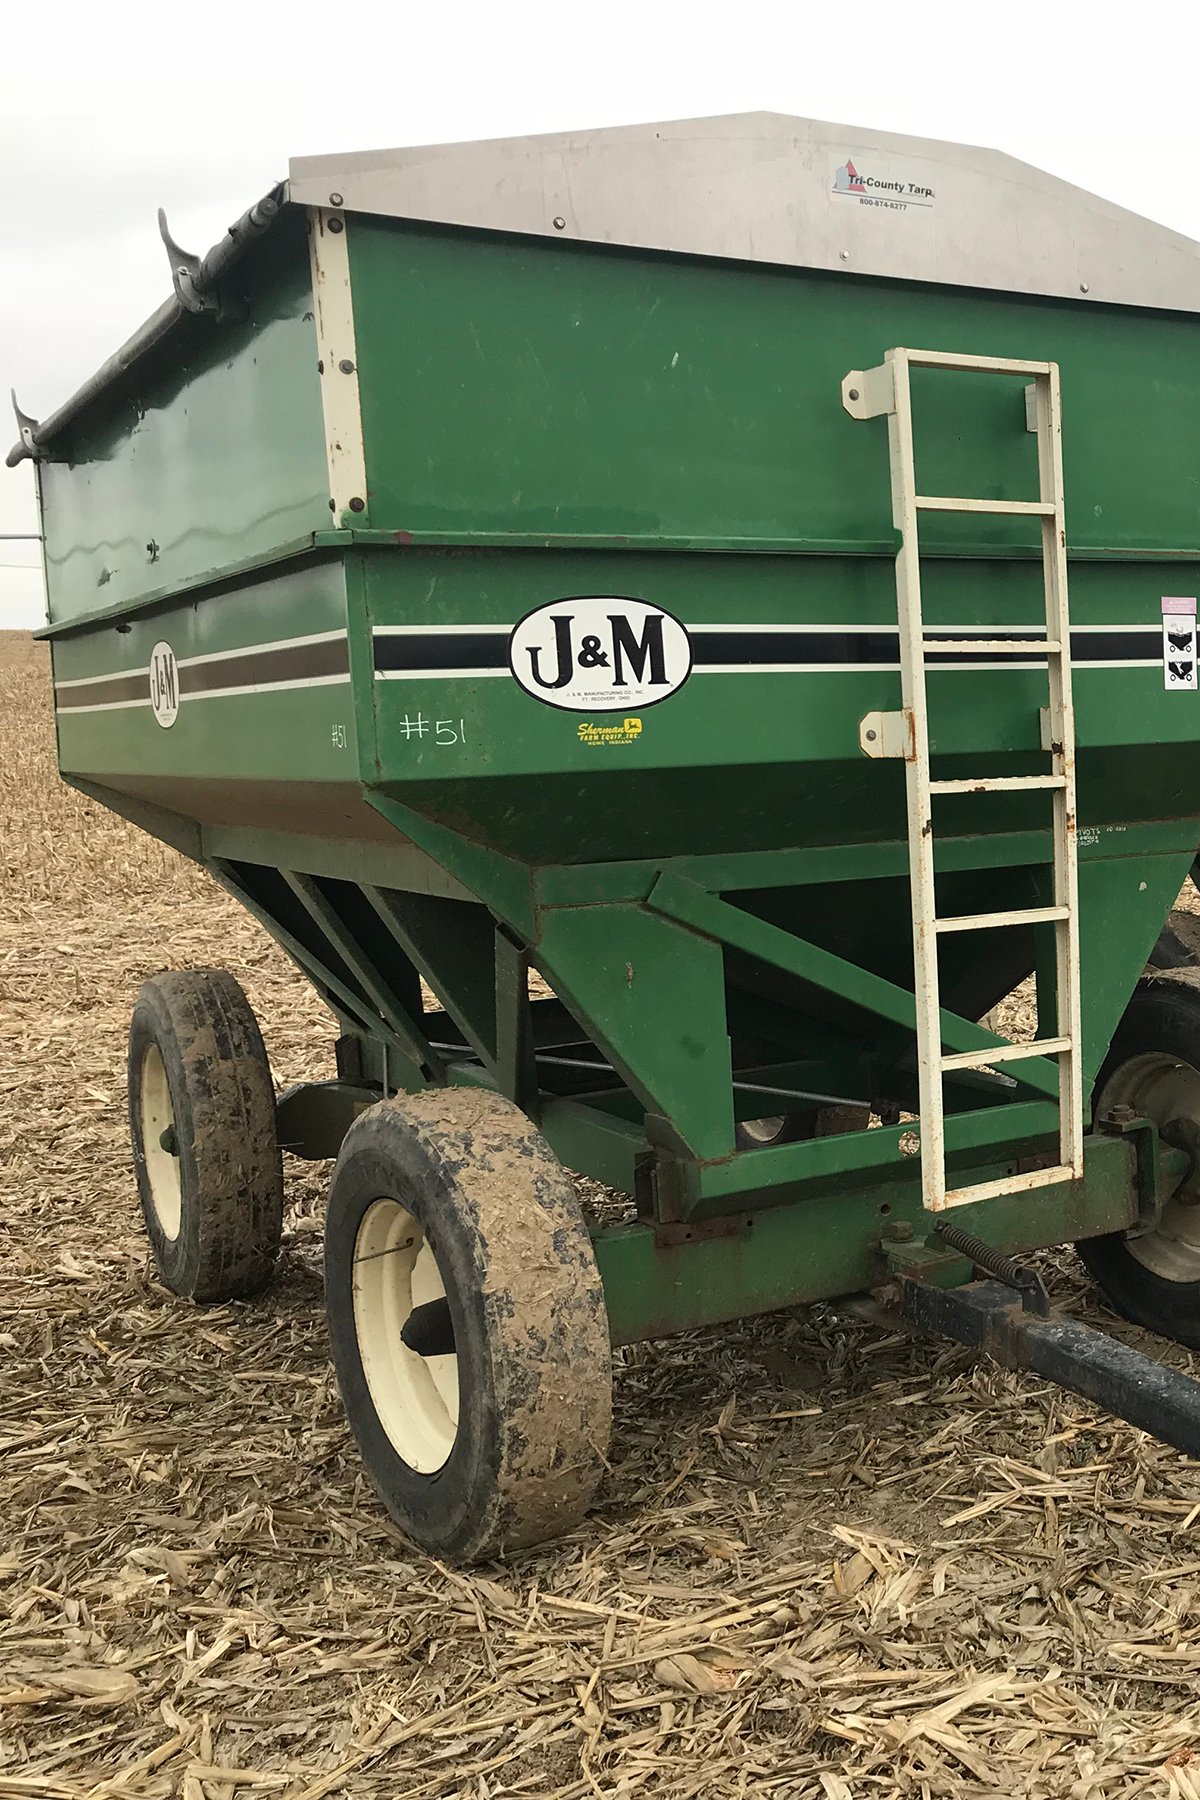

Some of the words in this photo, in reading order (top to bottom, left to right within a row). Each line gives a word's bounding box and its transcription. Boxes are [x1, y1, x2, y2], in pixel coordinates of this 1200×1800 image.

[848, 174, 905, 193] Tri-County
[907, 183, 933, 196] Tarp
[859, 198, 907, 210] 800-874-8277
[525, 615, 670, 689] J&M
[331, 724, 347, 748] #51
[400, 712, 466, 745] #51
[577, 723, 624, 735] Sherman
